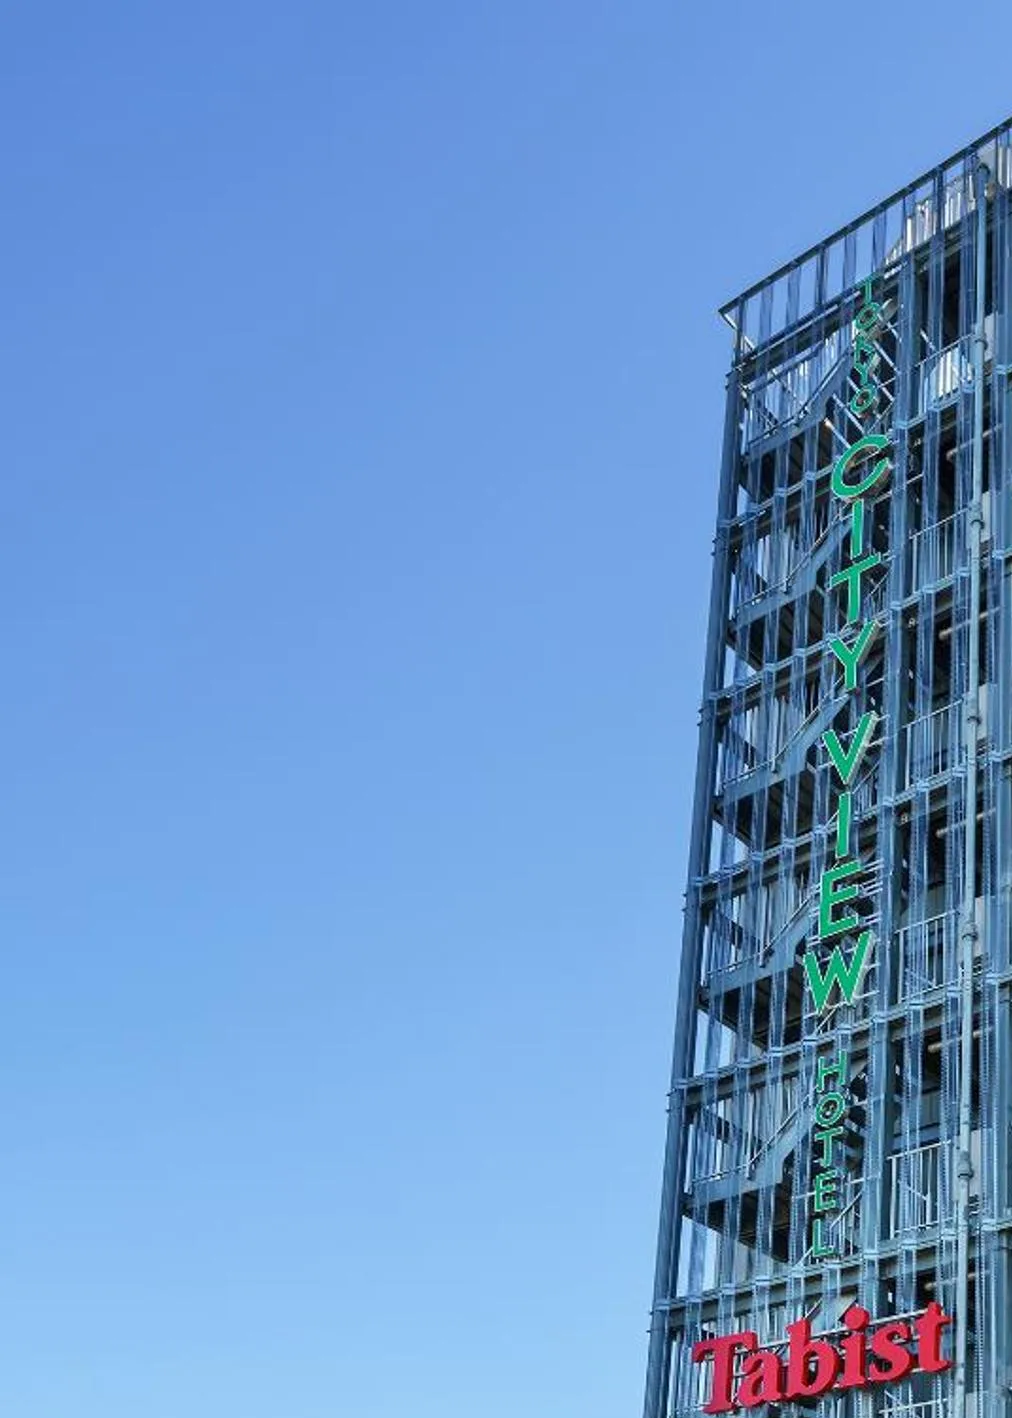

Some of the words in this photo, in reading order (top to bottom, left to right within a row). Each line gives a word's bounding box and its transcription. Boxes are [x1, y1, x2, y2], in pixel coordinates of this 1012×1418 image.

[830, 433, 890, 691] CITY
[802, 711, 873, 1015] VIEW
[812, 1049, 847, 1258] HOTEL
[692, 1301, 953, 1414] Tabist
